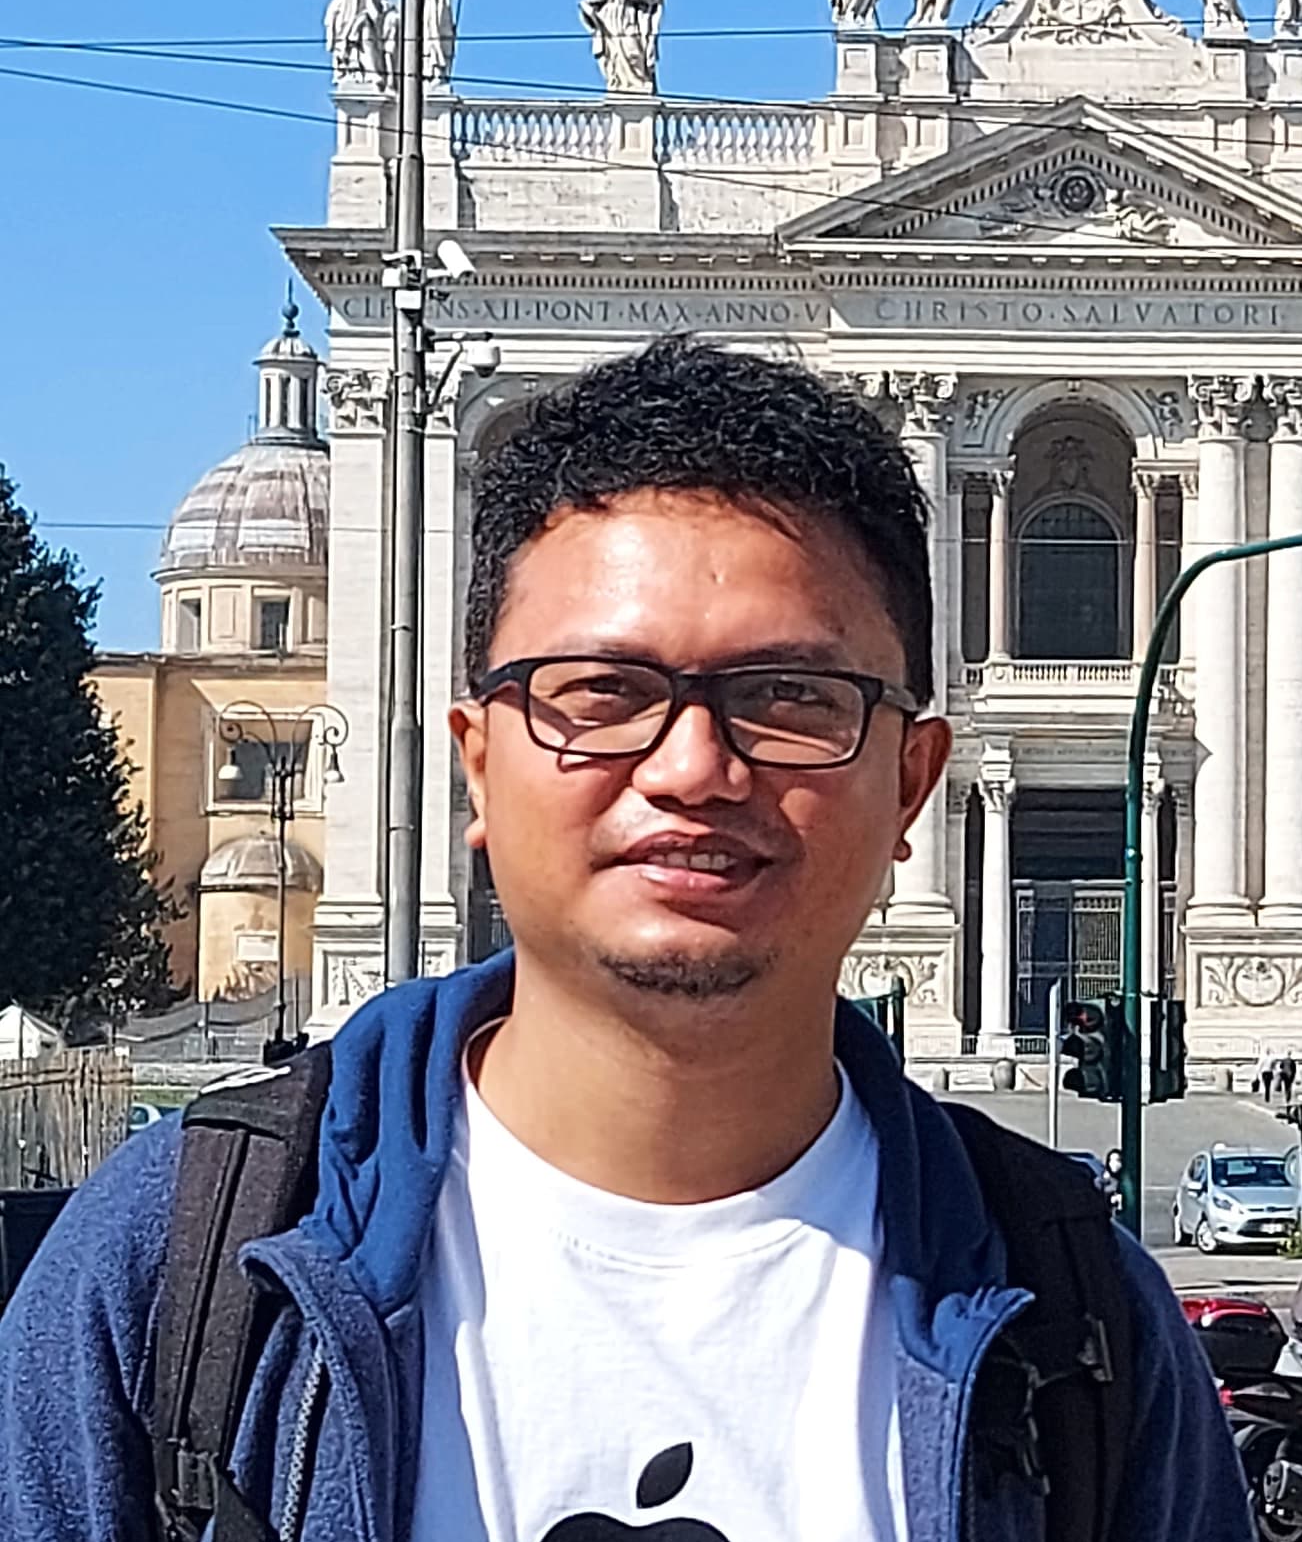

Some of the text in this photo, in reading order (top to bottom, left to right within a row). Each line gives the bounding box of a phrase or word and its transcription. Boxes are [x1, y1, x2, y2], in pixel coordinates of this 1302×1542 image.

[343, 297, 469, 320] CLENS
[628, 300, 690, 323] MAX
[705, 301, 790, 323] ANNO
[875, 299, 1279, 326] CHRISTO SALVATORI
